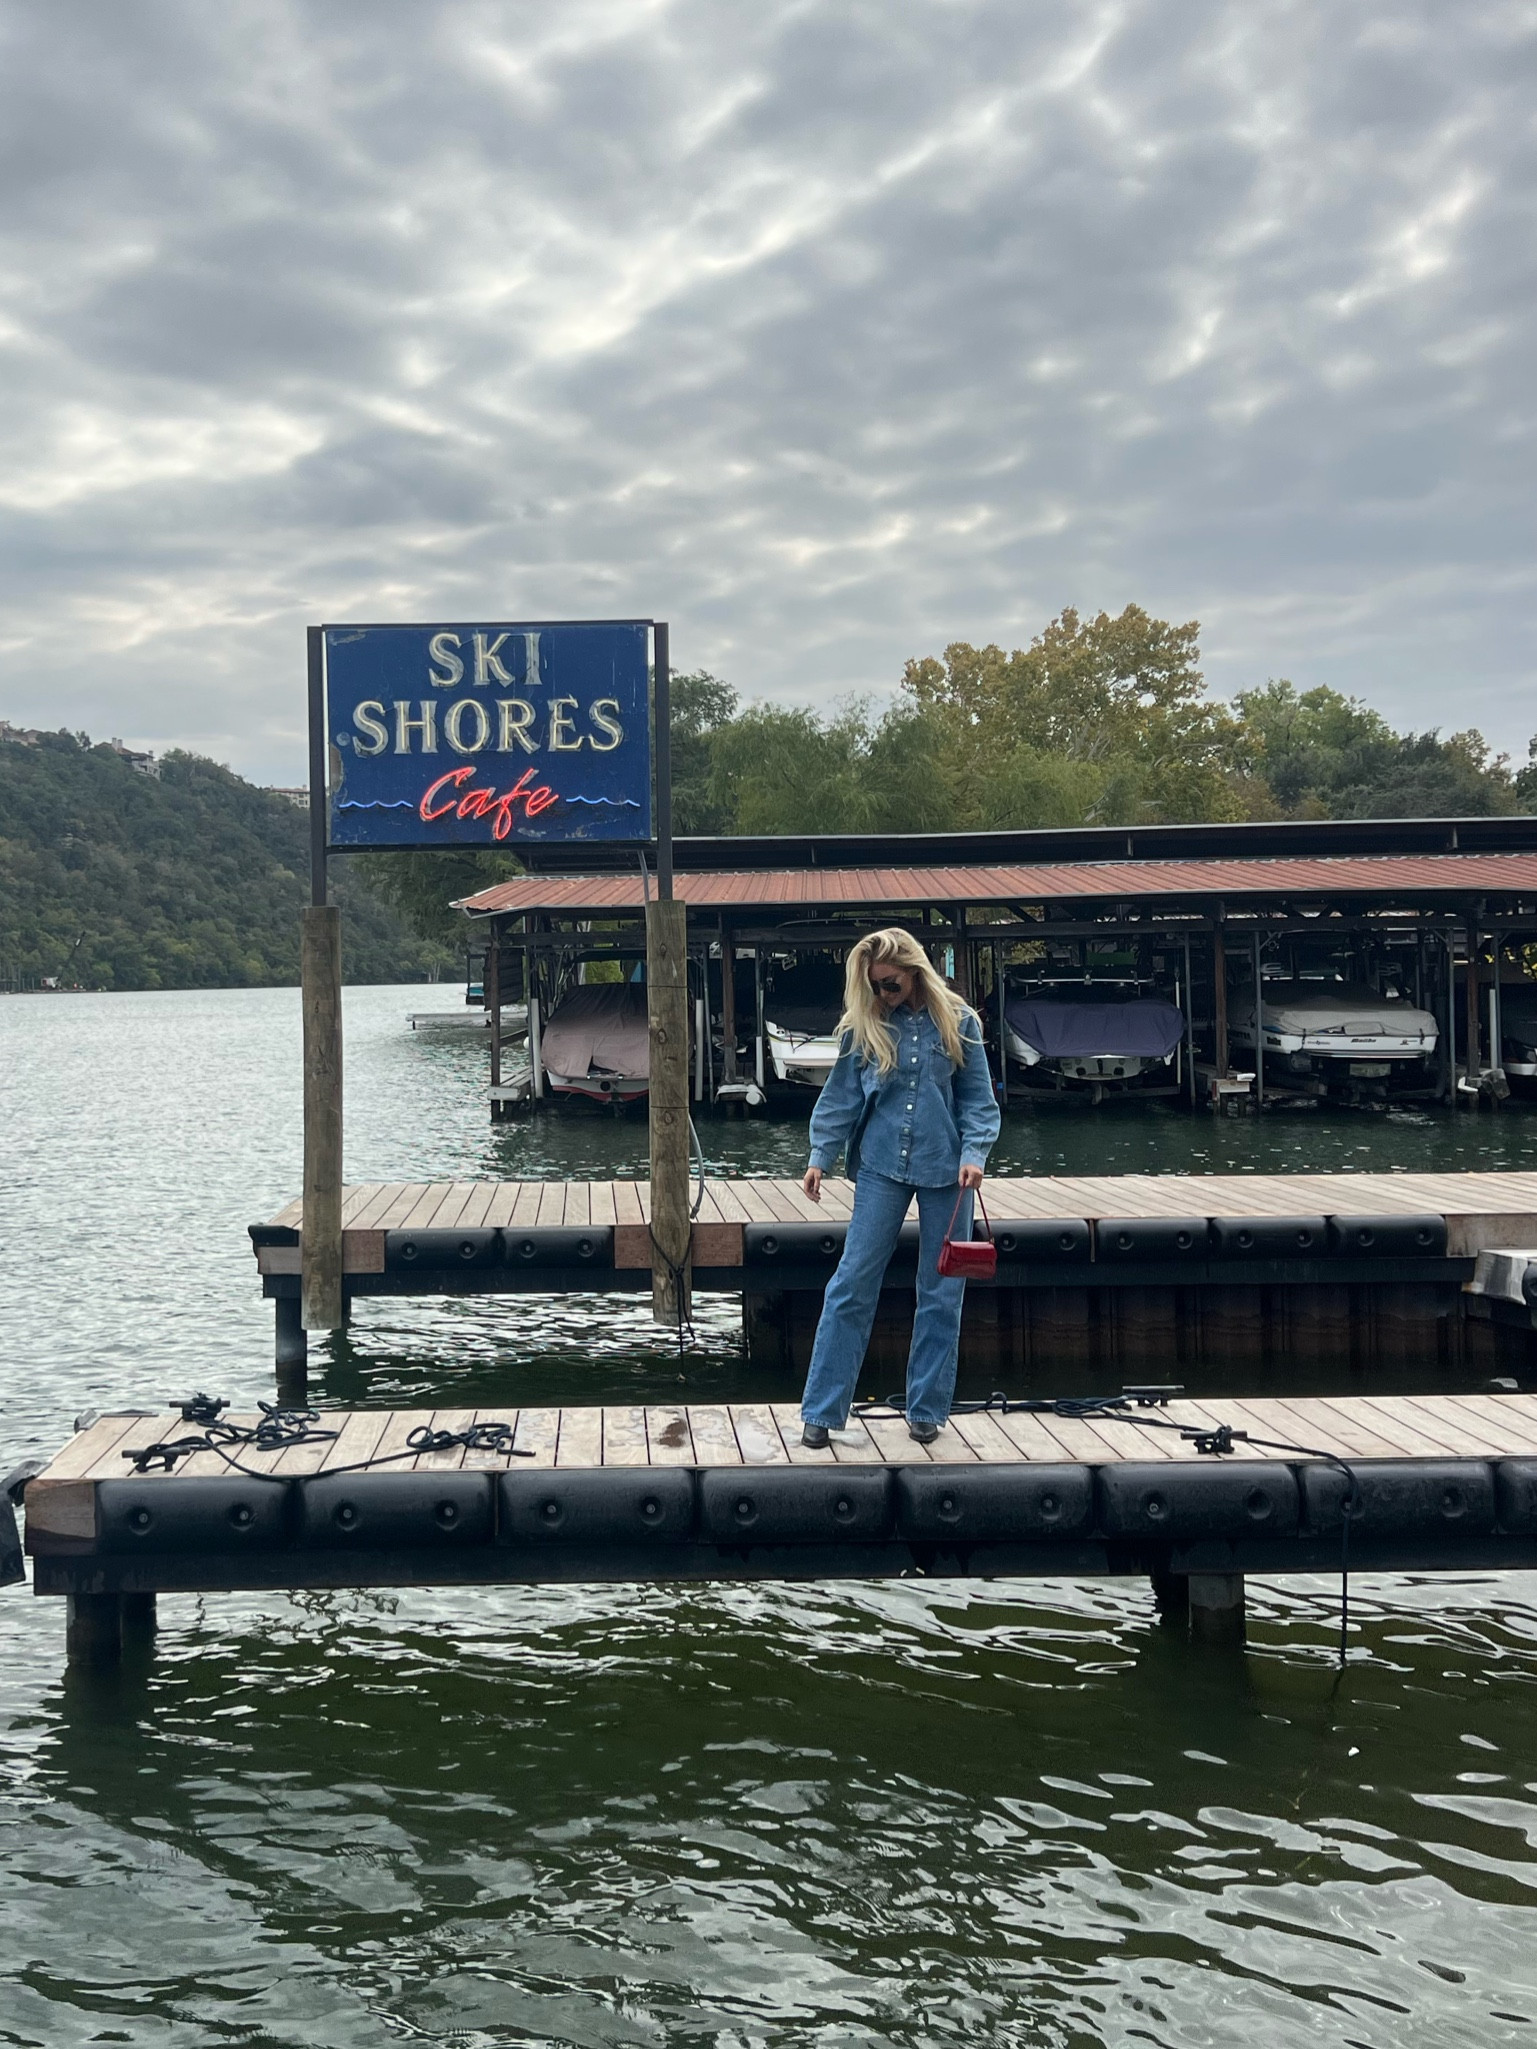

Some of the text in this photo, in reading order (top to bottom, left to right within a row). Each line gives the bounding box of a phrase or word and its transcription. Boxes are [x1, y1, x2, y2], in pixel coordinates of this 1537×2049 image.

[429, 632, 543, 688] SKI
[352, 694, 624, 758] SHORES
[420, 766, 559, 840] Cafe
